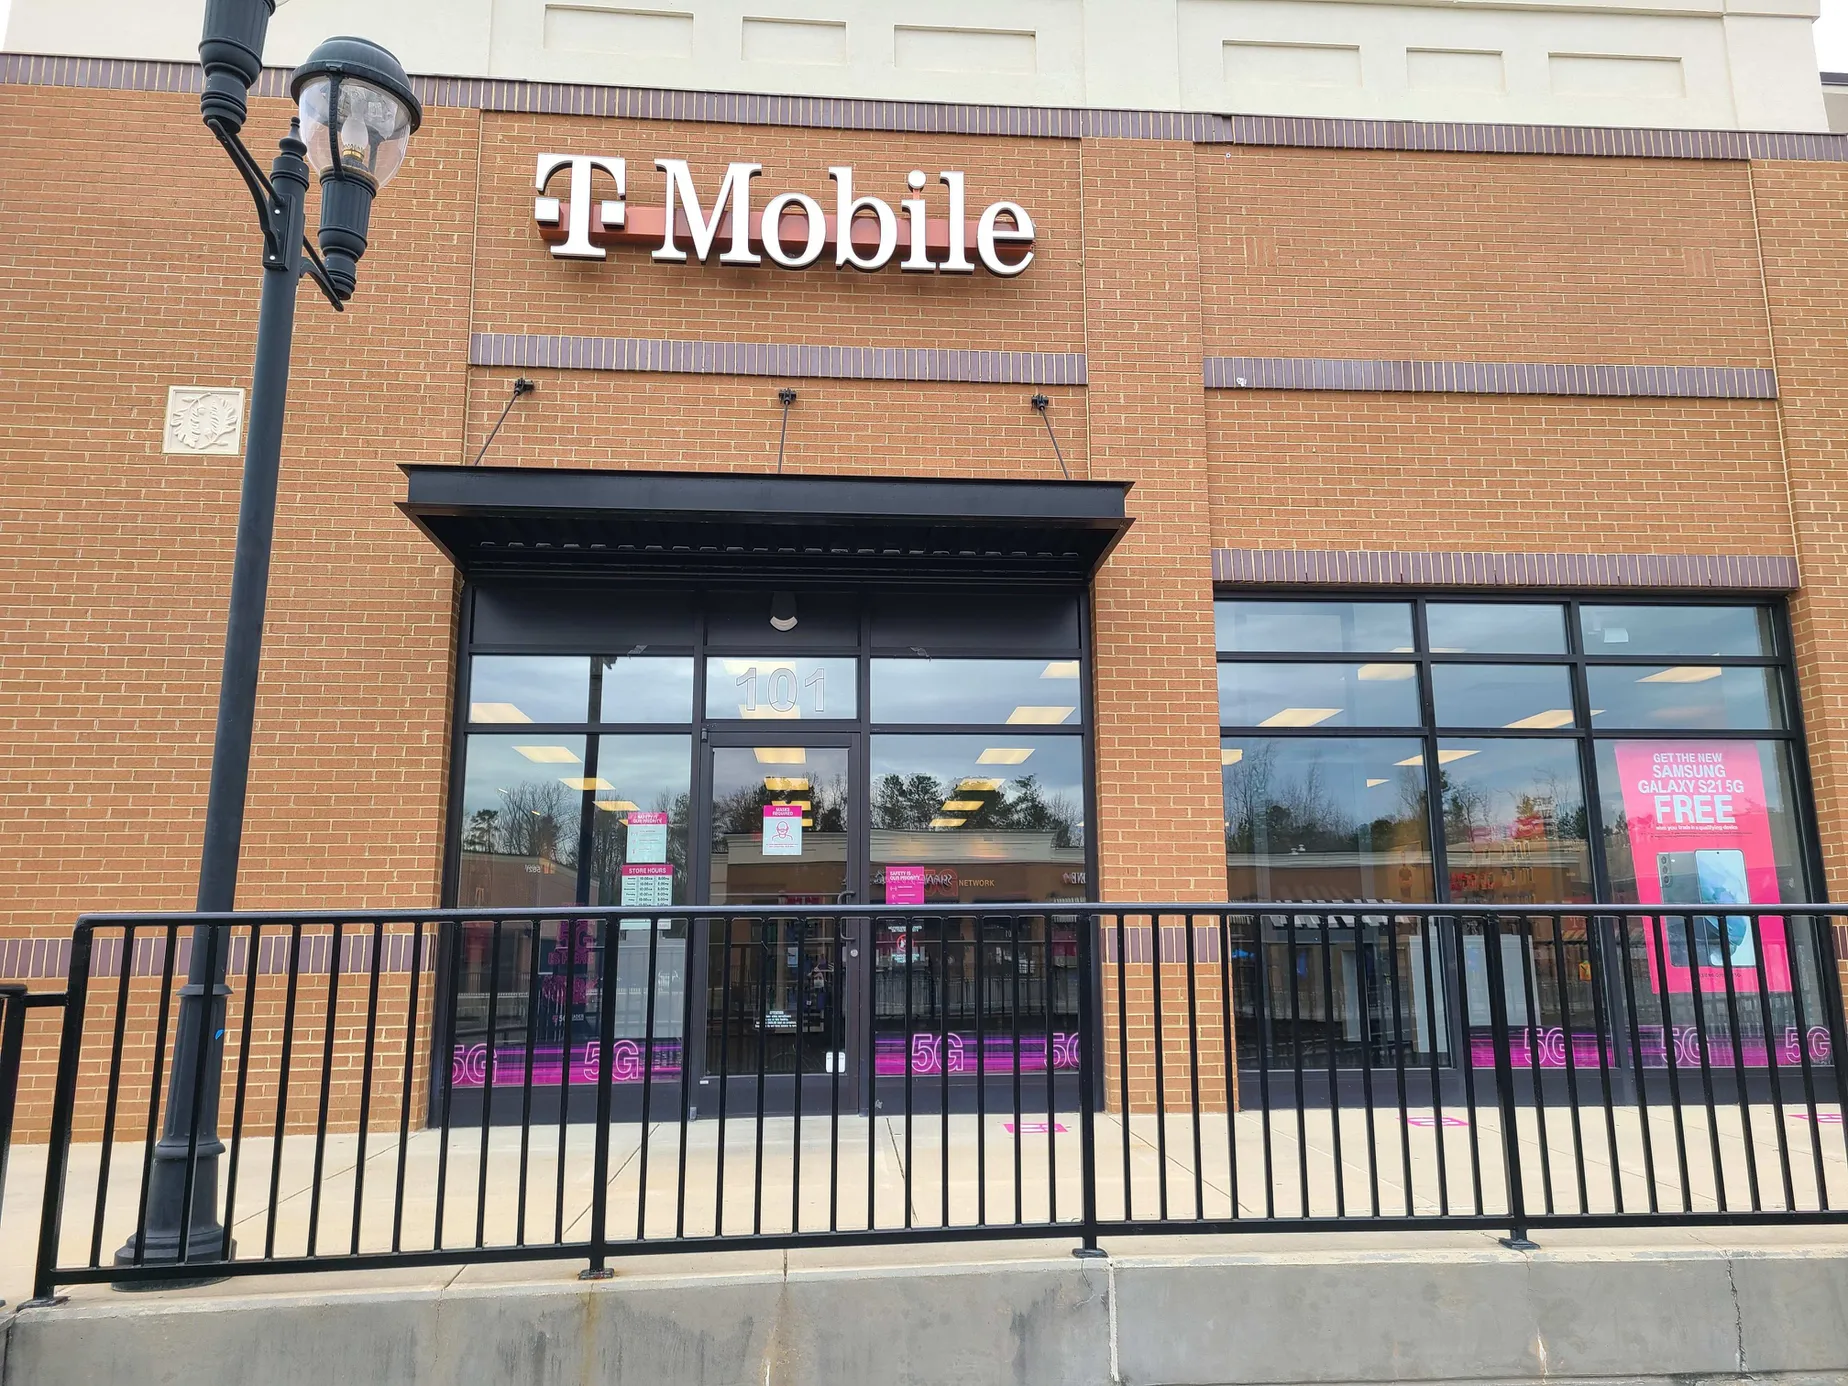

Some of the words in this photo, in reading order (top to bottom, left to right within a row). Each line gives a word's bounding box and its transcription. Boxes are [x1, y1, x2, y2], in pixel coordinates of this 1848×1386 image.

[652, 158, 1036, 277] Mobile
[735, 667, 824, 712] 101
[1653, 753, 1674, 763] GET
[1676, 753, 1695, 762] THE
[1698, 753, 1722, 763] NEW
[1652, 764, 1726, 778] SAMSUNG
[1638, 780, 1695, 794] GALAXY
[1698, 780, 1722, 793] S21
[1726, 780, 1744, 793] 5G
[1654, 795, 1735, 824] FREE
[959, 879, 995, 887] NETWORK
[911, 1032, 965, 1073] 5G
